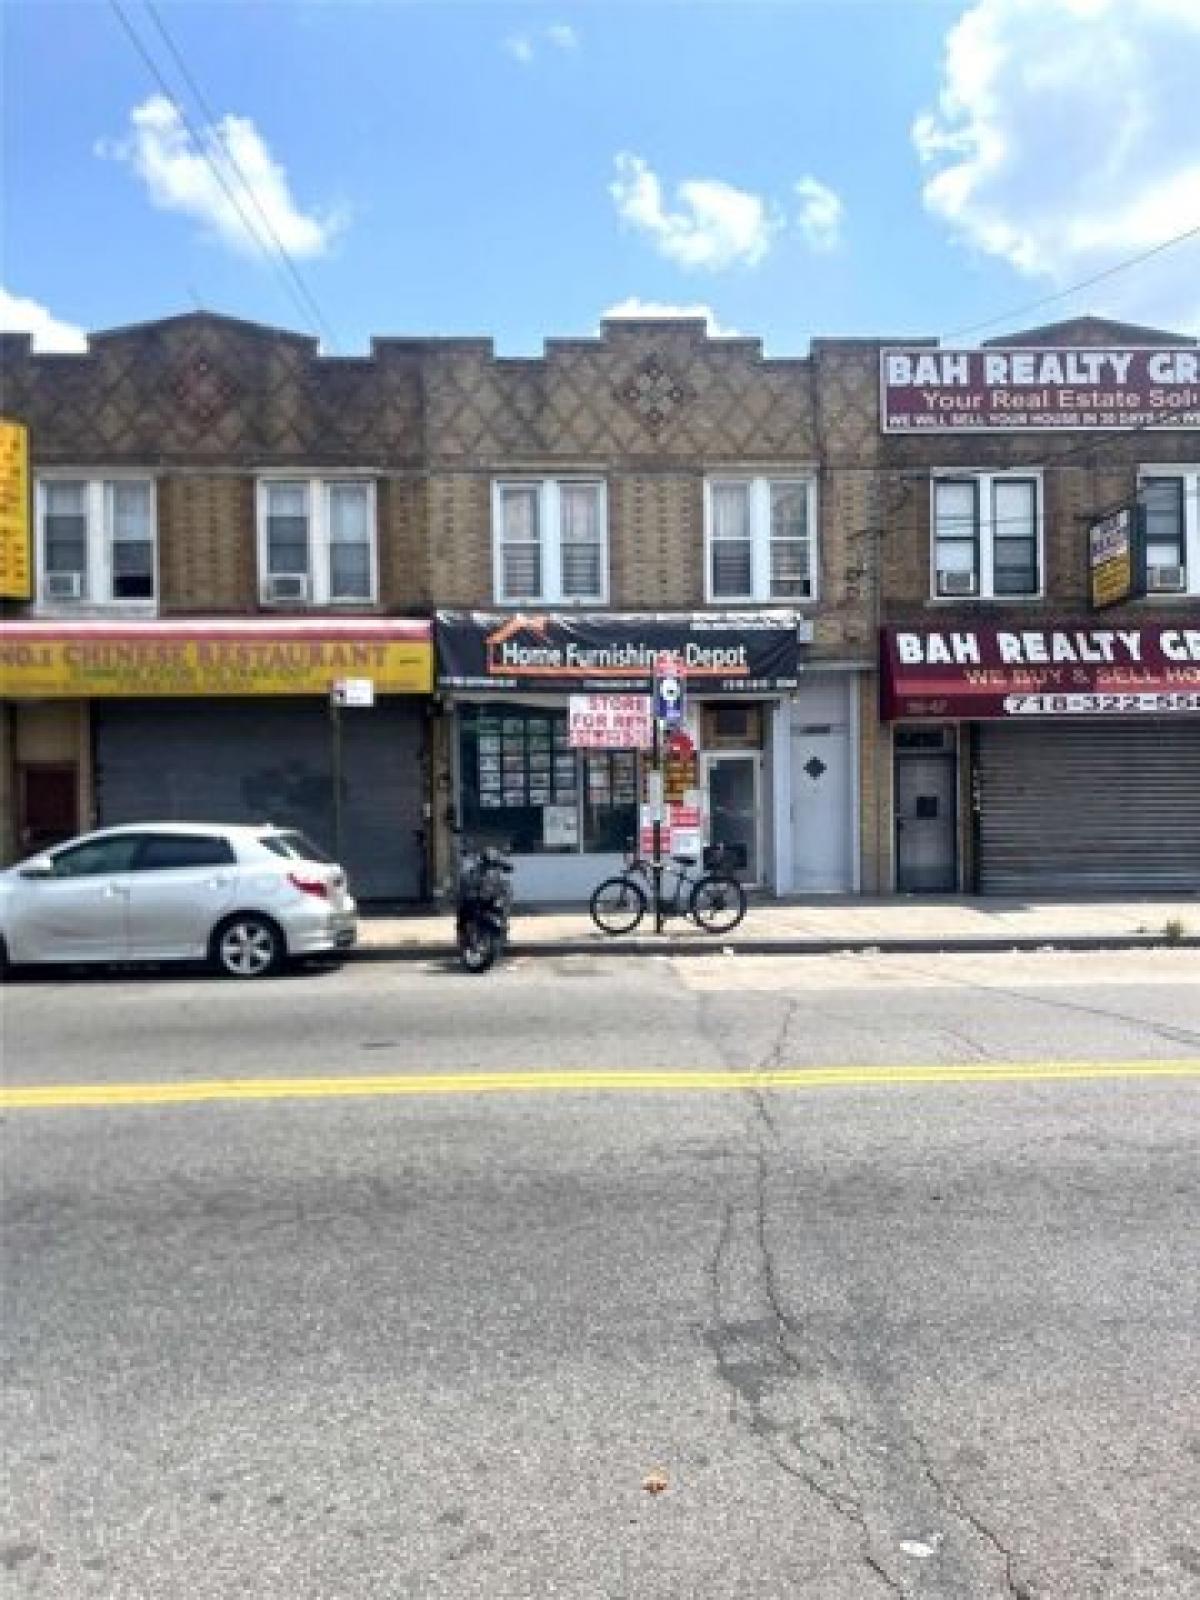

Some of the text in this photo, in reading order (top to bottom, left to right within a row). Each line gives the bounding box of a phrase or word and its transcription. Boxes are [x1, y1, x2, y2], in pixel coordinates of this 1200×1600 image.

[888, 352, 1199, 385] BAH REALTY GR
[923, 391, 983, 410] Your
[992, 390, 1048, 408] Real
[1059, 390, 1140, 408] Estate
[63, 641, 186, 667] CHINESE
[196, 641, 387, 667] RESTAURANT
[502, 642, 561, 667] Home
[686, 642, 748, 674] Depot
[897, 632, 981, 664] BAH
[996, 632, 1141, 663] REALTY
[963, 669, 1007, 685] WE
[1012, 669, 1063, 685] BUY
[1072, 669, 1090, 684] &
[1096, 668, 1161, 684] SELL
[589, 696, 642, 711] STORE
[572, 713, 608, 727] FOR
